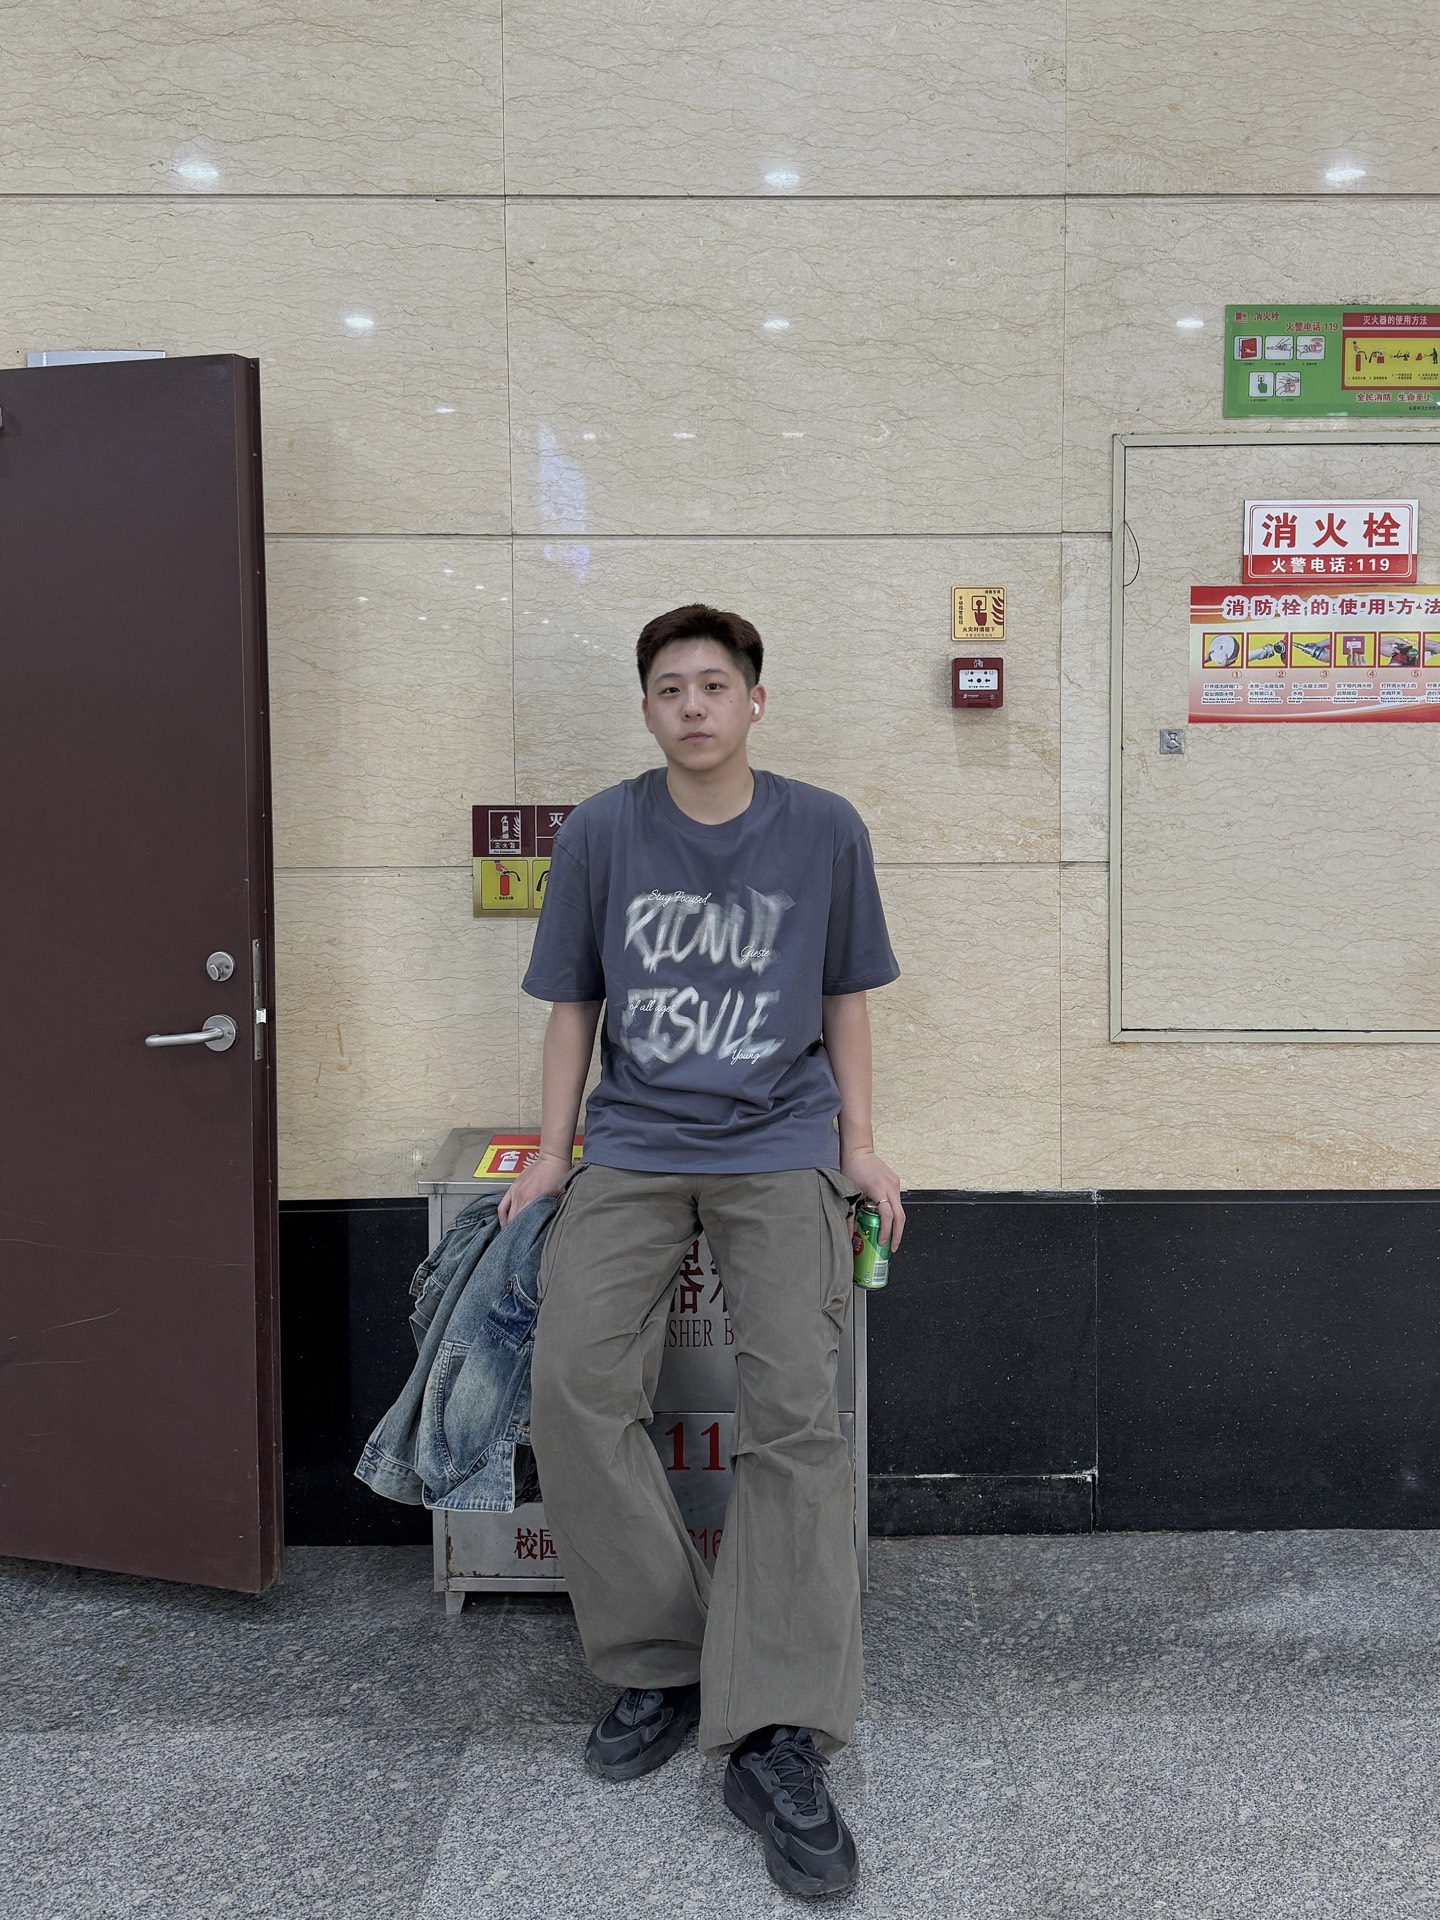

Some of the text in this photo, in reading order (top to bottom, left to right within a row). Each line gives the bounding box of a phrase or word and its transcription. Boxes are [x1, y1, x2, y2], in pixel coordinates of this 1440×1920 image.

[1254, 312, 1279, 321] 消火栓
[1363, 315, 1428, 325] 灭火器的使用方法
[1286, 322, 1338, 332] 火警电话 119
[1261, 511, 1401, 549] 消火栓
[1270, 557, 1390, 574] 火警电话:119
[1226, 598, 1440, 616] 消防栓的使用方法
[647, 889, 712, 907] Stay Focused
[629, 999, 676, 1018] of all ages
[731, 1048, 760, 1066] Young
